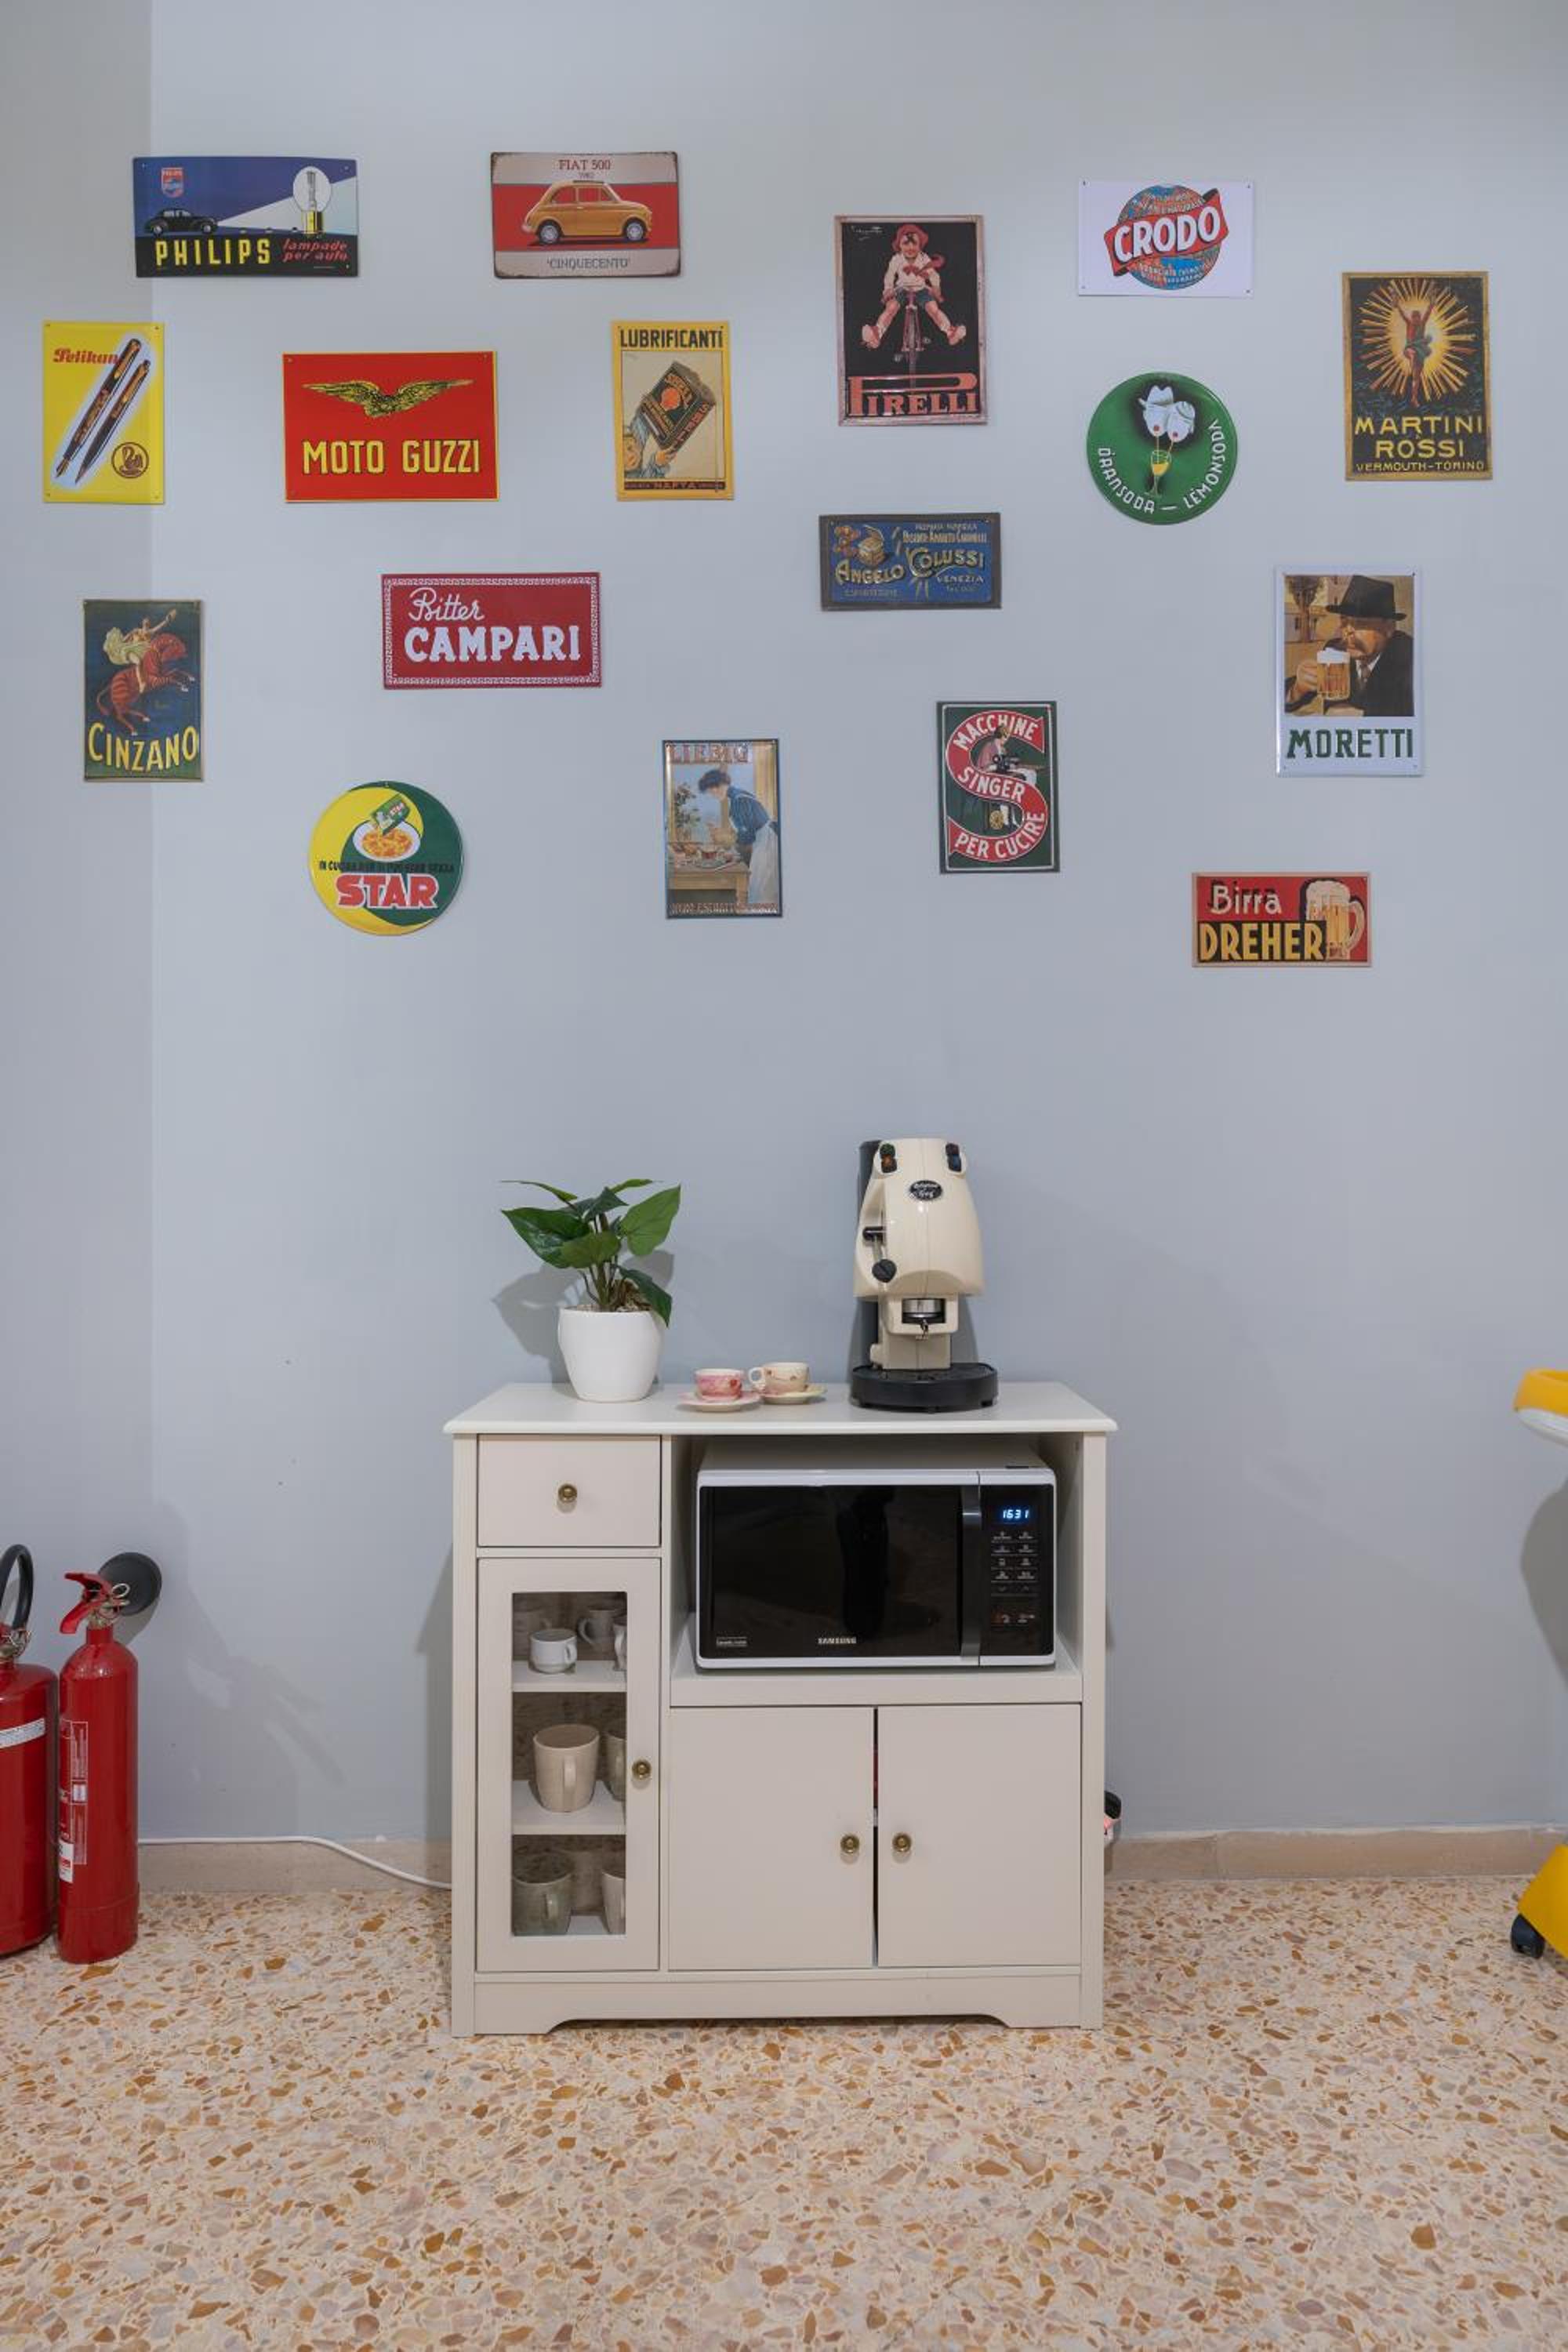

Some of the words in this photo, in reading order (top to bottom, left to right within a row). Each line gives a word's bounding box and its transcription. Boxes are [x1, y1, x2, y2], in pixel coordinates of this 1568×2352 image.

[558, 159, 588, 170] FIAT
[591, 159, 612, 170] 500
[283, 238, 348, 252] lampade
[1113, 205, 1221, 263] CRODO
[154, 238, 270, 267] PHILIPS
[283, 252, 309, 263] per
[619, 329, 724, 348] LUBRIFICANTI
[53, 347, 122, 364] Pelikan
[848, 372, 978, 416] PIRELLI
[1354, 416, 1483, 435] MARTINI
[302, 440, 386, 474] MOTO
[401, 438, 481, 474] GUZZI
[1374, 439, 1464, 459] ROSSI
[408, 587, 486, 622] Bitter
[404, 625, 582, 662] CAMPARI
[88, 721, 200, 772] CINZANO
[952, 713, 1039, 752] MACCHINE
[1286, 728, 1414, 759] MORETTI
[957, 766, 1026, 804] SINGER
[954, 833, 991, 859] PER
[994, 811, 1045, 859] CUCIRE
[335, 872, 438, 909] STAR
[1209, 884, 1283, 915] Birra
[1199, 922, 1327, 961] DREHER
[818, 1636, 857, 1645] SAMSUNG
